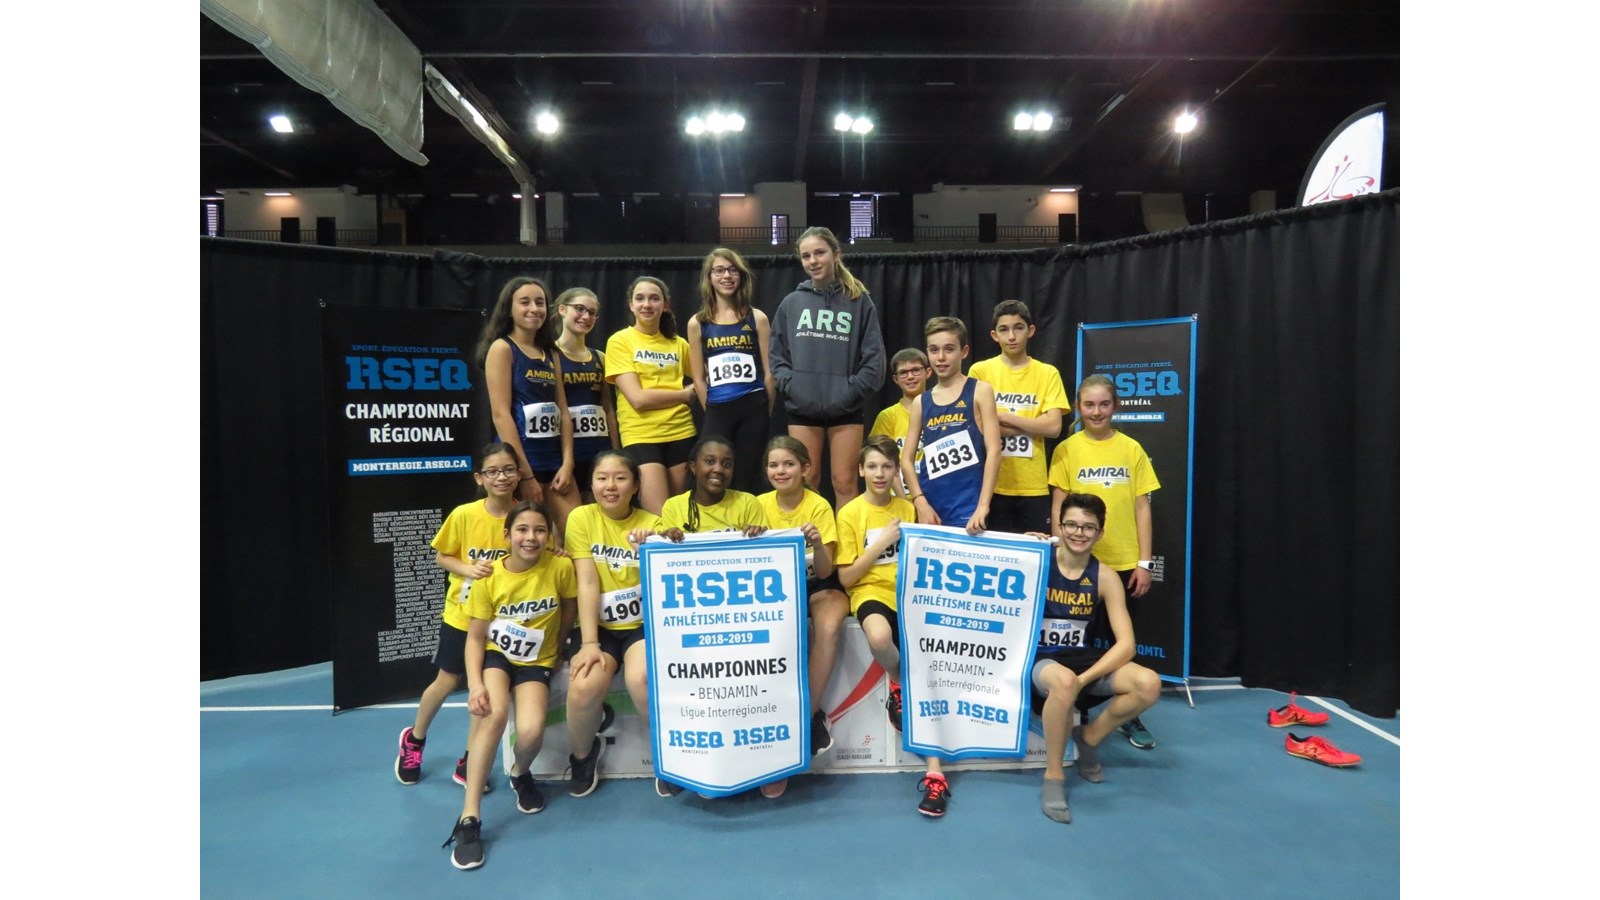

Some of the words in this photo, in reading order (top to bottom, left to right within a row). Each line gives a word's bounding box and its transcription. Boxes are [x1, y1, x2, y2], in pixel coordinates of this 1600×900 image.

[796, 308, 853, 334] ARS
[707, 334, 753, 348] AMIRAL
[635, 350, 680, 361] AMIRAL
[345, 356, 473, 390] RSEQ
[525, 369, 556, 381] AMIRA
[564, 372, 603, 384] AMIR
[712, 364, 753, 382] 1892
[1091, 371, 1182, 397] SEQ
[996, 392, 1039, 405] MIRAL
[1120, 398, 1152, 406] ONTRÉAL
[345, 403, 470, 420] CHAMPIONNAT
[529, 415, 560, 434] 189
[571, 417, 606, 433] 1893
[926, 412, 967, 428] AMIRAL
[370, 423, 454, 443] RÉGIONAL
[936, 439, 956, 452] RSEQ
[352, 459, 468, 472] MONTEREGIE.RSEQ.CA
[929, 444, 973, 474] 1933
[1077, 467, 1130, 479] AMIRAL
[468, 548, 508, 561] AMIR
[666, 560, 694, 568] SPORT.
[695, 558, 743, 566] ÉDUCATION.
[744, 556, 774, 564] FIERTÉ.
[913, 557, 1028, 601] RSEQ
[614, 591, 637, 602] RSEQ
[661, 569, 788, 609] RSEQ
[604, 597, 643, 622] 190
[912, 594, 972, 611] ATHLÉTISME
[974, 602, 987, 613] EN
[990, 604, 1021, 617] SALLE
[1069, 606, 1093, 615] JDLM
[663, 611, 730, 627] ATHLÉTISME
[734, 613, 748, 623] EN
[751, 610, 784, 622] SALLE
[939, 616, 990, 631] 2018-2019
[505, 625, 527, 638] RSEQ
[698, 632, 753, 645] 2018-2019
[1039, 630, 1081, 646] 1945
[490, 629, 537, 657] 1917
[920, 637, 1007, 662] CHAMPIONS
[1137, 643, 1167, 658] QMTL
[668, 657, 787, 679] CHAMPIONNES
[699, 685, 758, 700] BENJAMIN
[939, 677, 1000, 695] Interrégionale
[681, 707, 706, 719] Ligue
[708, 702, 777, 718] Interrégionale
[957, 700, 1009, 724] RSEQ
[669, 729, 724, 748] RSEQ
[733, 724, 790, 746] RSEQ
